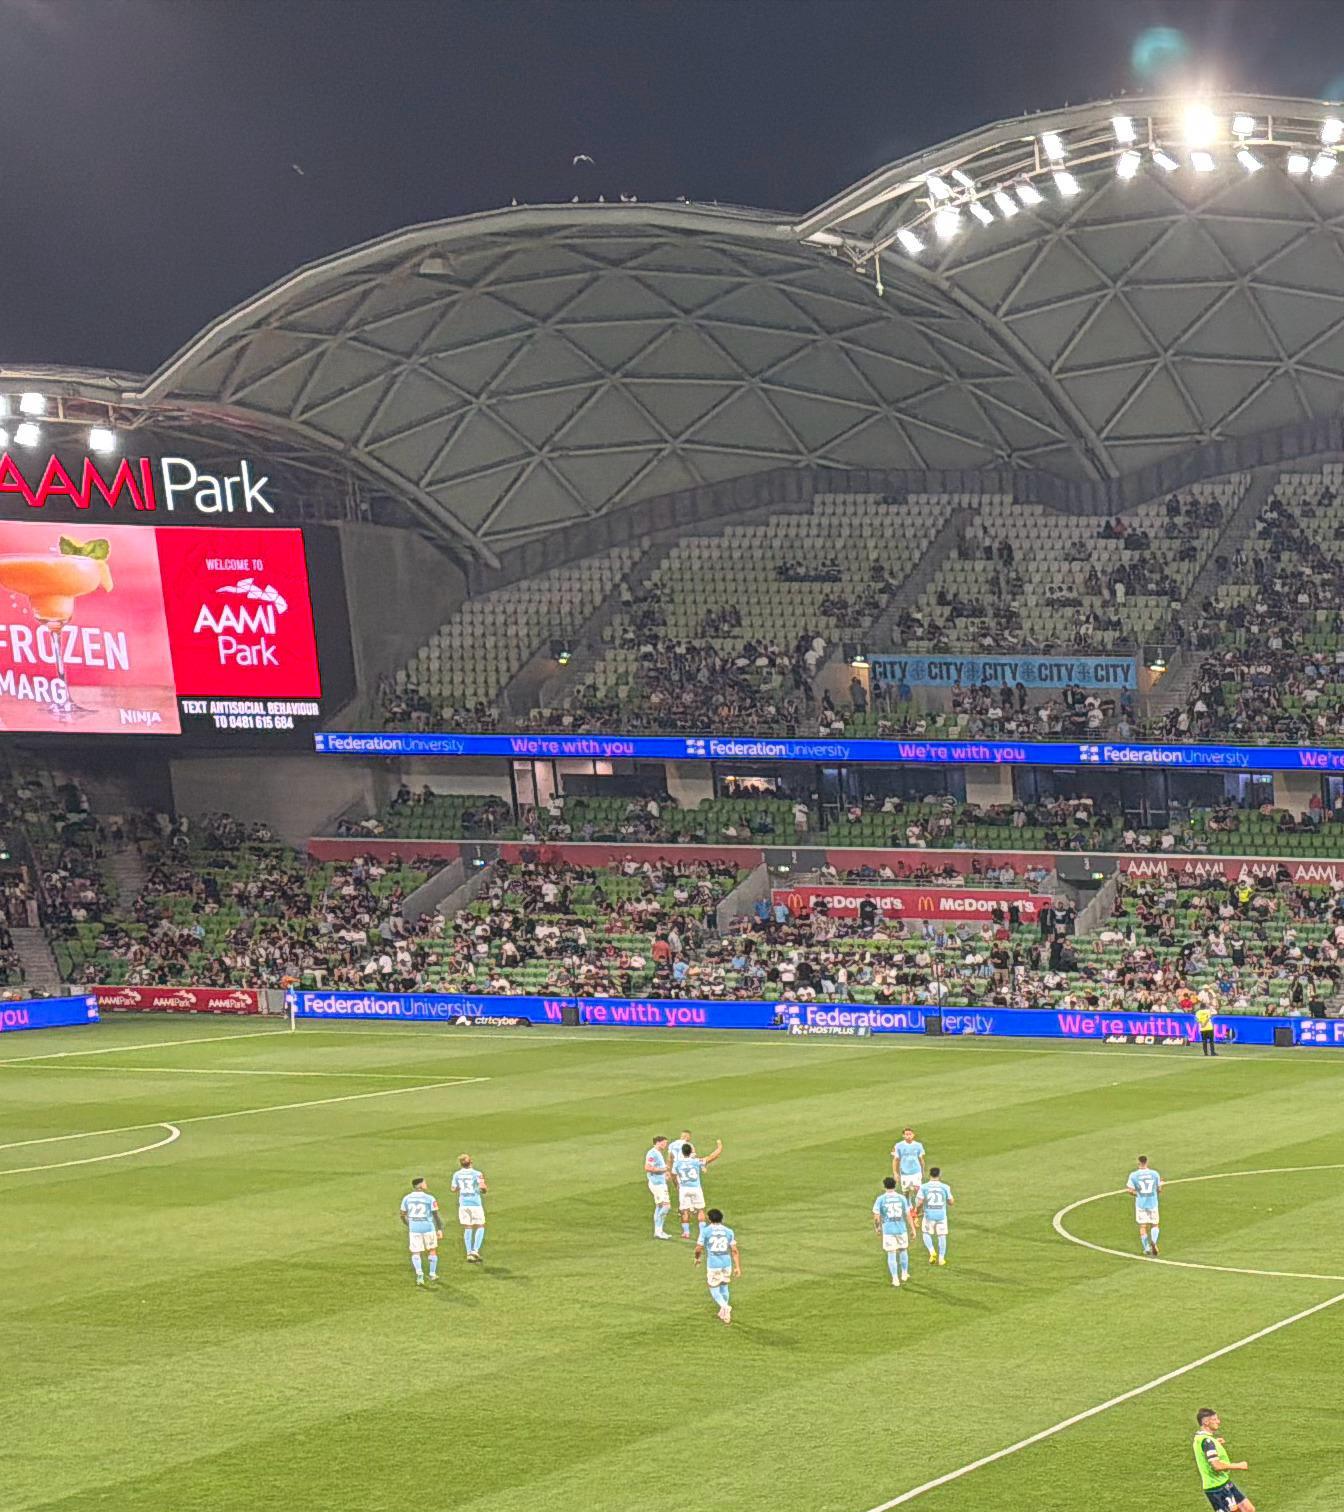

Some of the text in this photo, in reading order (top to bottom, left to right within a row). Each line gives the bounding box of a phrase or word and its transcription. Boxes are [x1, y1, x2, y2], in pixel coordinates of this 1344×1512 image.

[0, 453, 274, 514] AAMI Park
[206, 558, 264, 572] WELCOME TO
[193, 603, 277, 635] AAMI
[217, 635, 280, 666] Park
[871, 660, 1130, 683] CITY CITY CITY CITY CITY
[182, 701, 320, 716] TEXT ANTISOCIAL BEHAVIOUR
[214, 715, 228, 728] TO
[511, 738, 634, 757] We're with you
[899, 743, 1025, 761] We're with you
[1127, 860, 1168, 877] AAMI
[1295, 865, 1336, 881] AAMI
[611, 1001, 706, 1027] with you
[1057, 1013, 1123, 1034] We're
[1128, 1016, 1181, 1036] with
